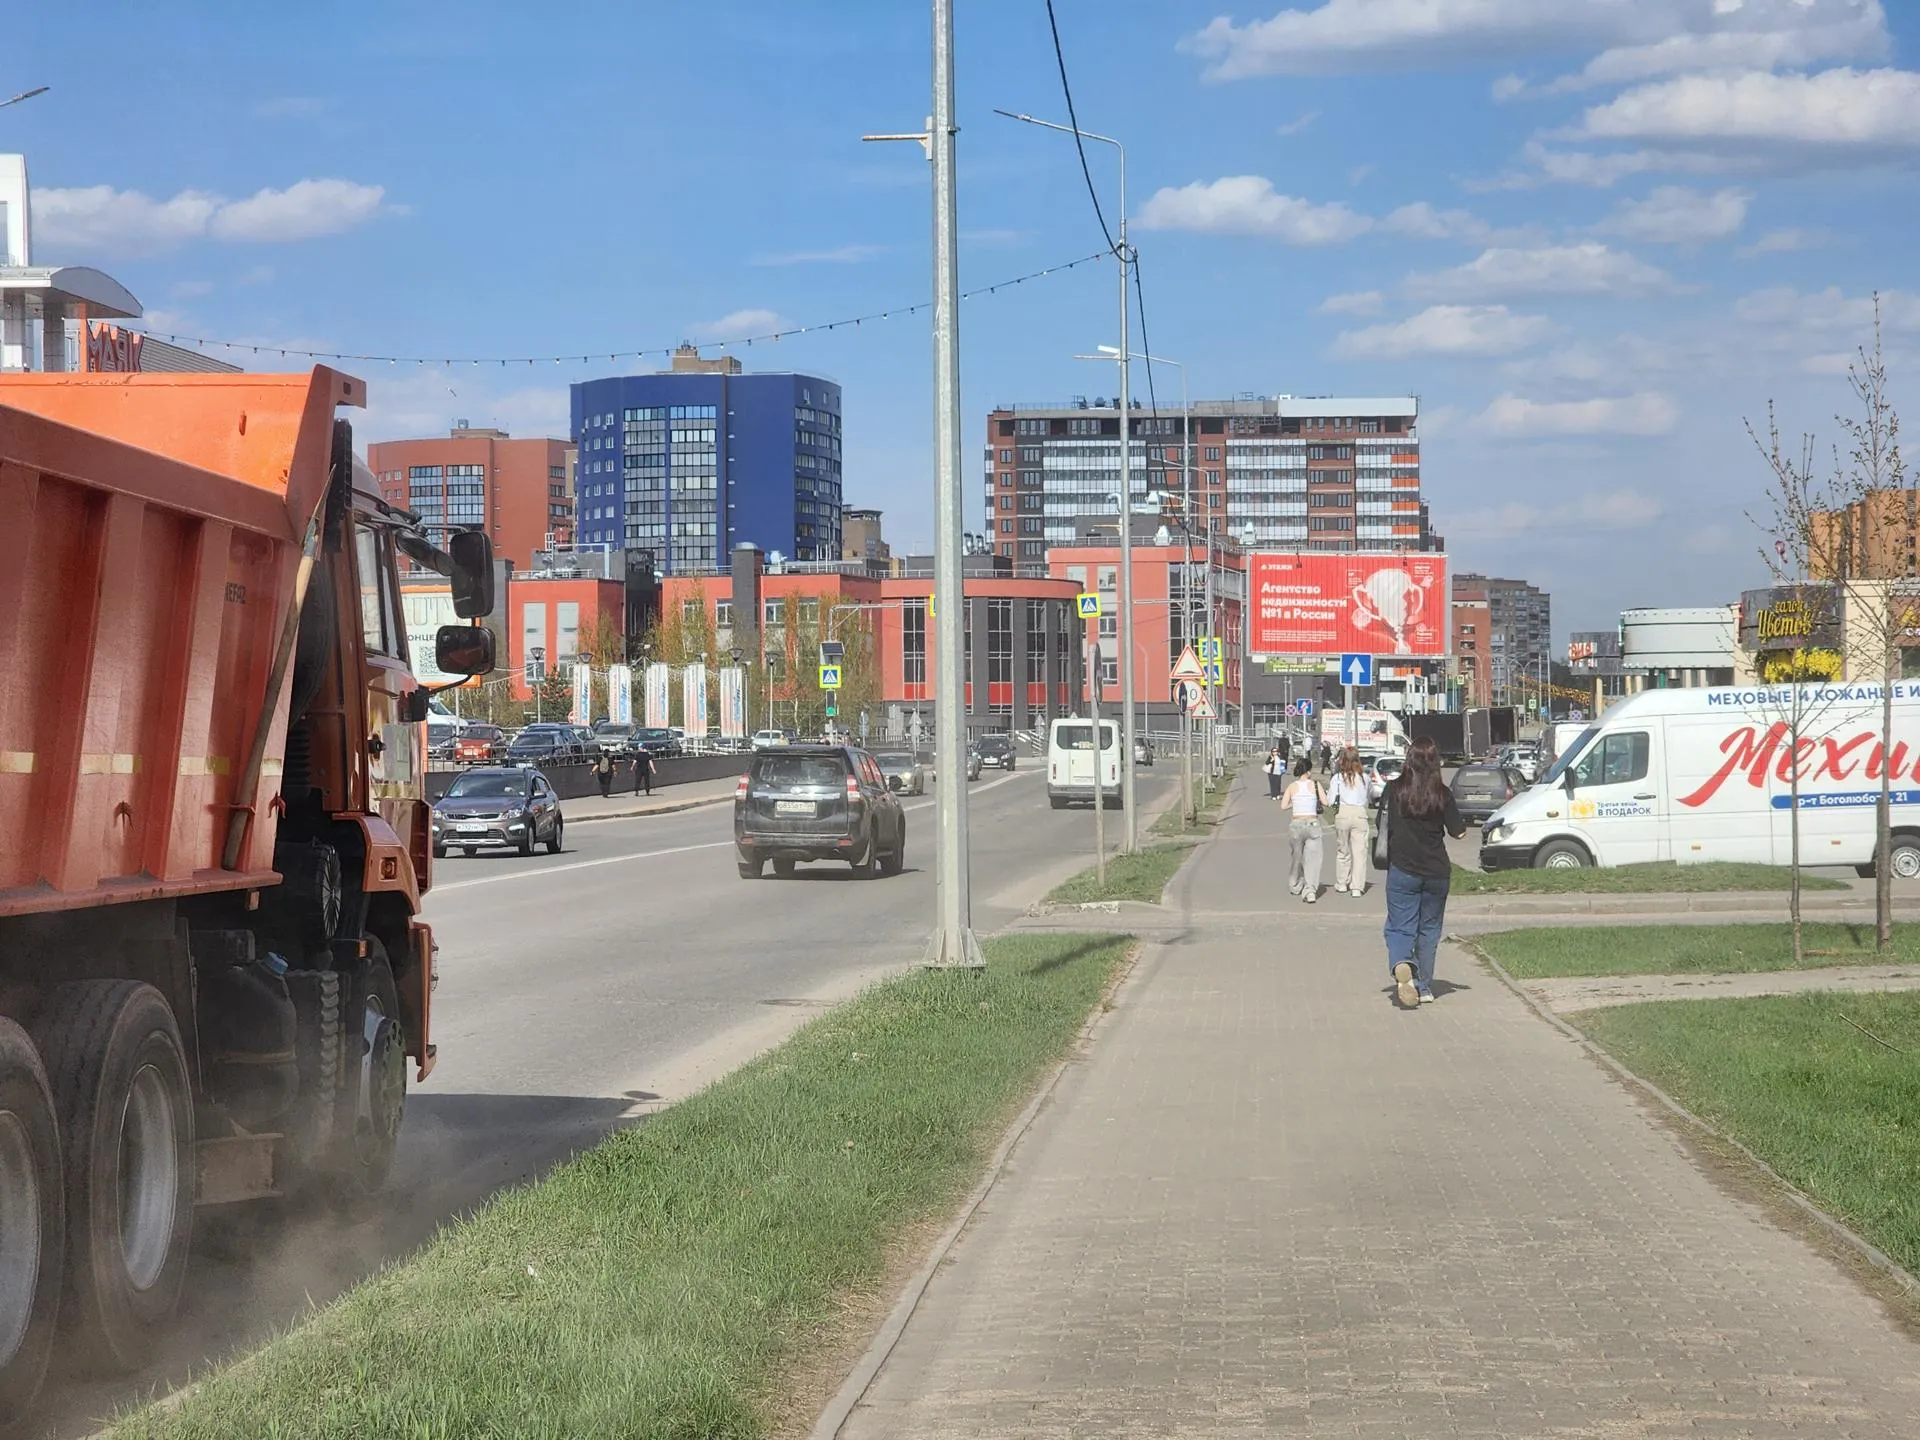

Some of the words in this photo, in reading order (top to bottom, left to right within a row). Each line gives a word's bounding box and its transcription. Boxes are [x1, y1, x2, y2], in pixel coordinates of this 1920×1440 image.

[1261, 582, 1321, 594] Агентство
[1261, 598, 1347, 608] недвижимости
[1261, 607, 1282, 619] №1
[1294, 608, 1336, 620] России
[407, 634, 437, 642] ОНЦЕ
[1707, 691, 1792, 706] МЕХОВЫЕ
[1677, 720, 1920, 807] Мехи
[1797, 797, 1817, 807] р-т
[1895, 791, 1908, 802] 21
[1605, 807, 1652, 816] ПОДАРОК
